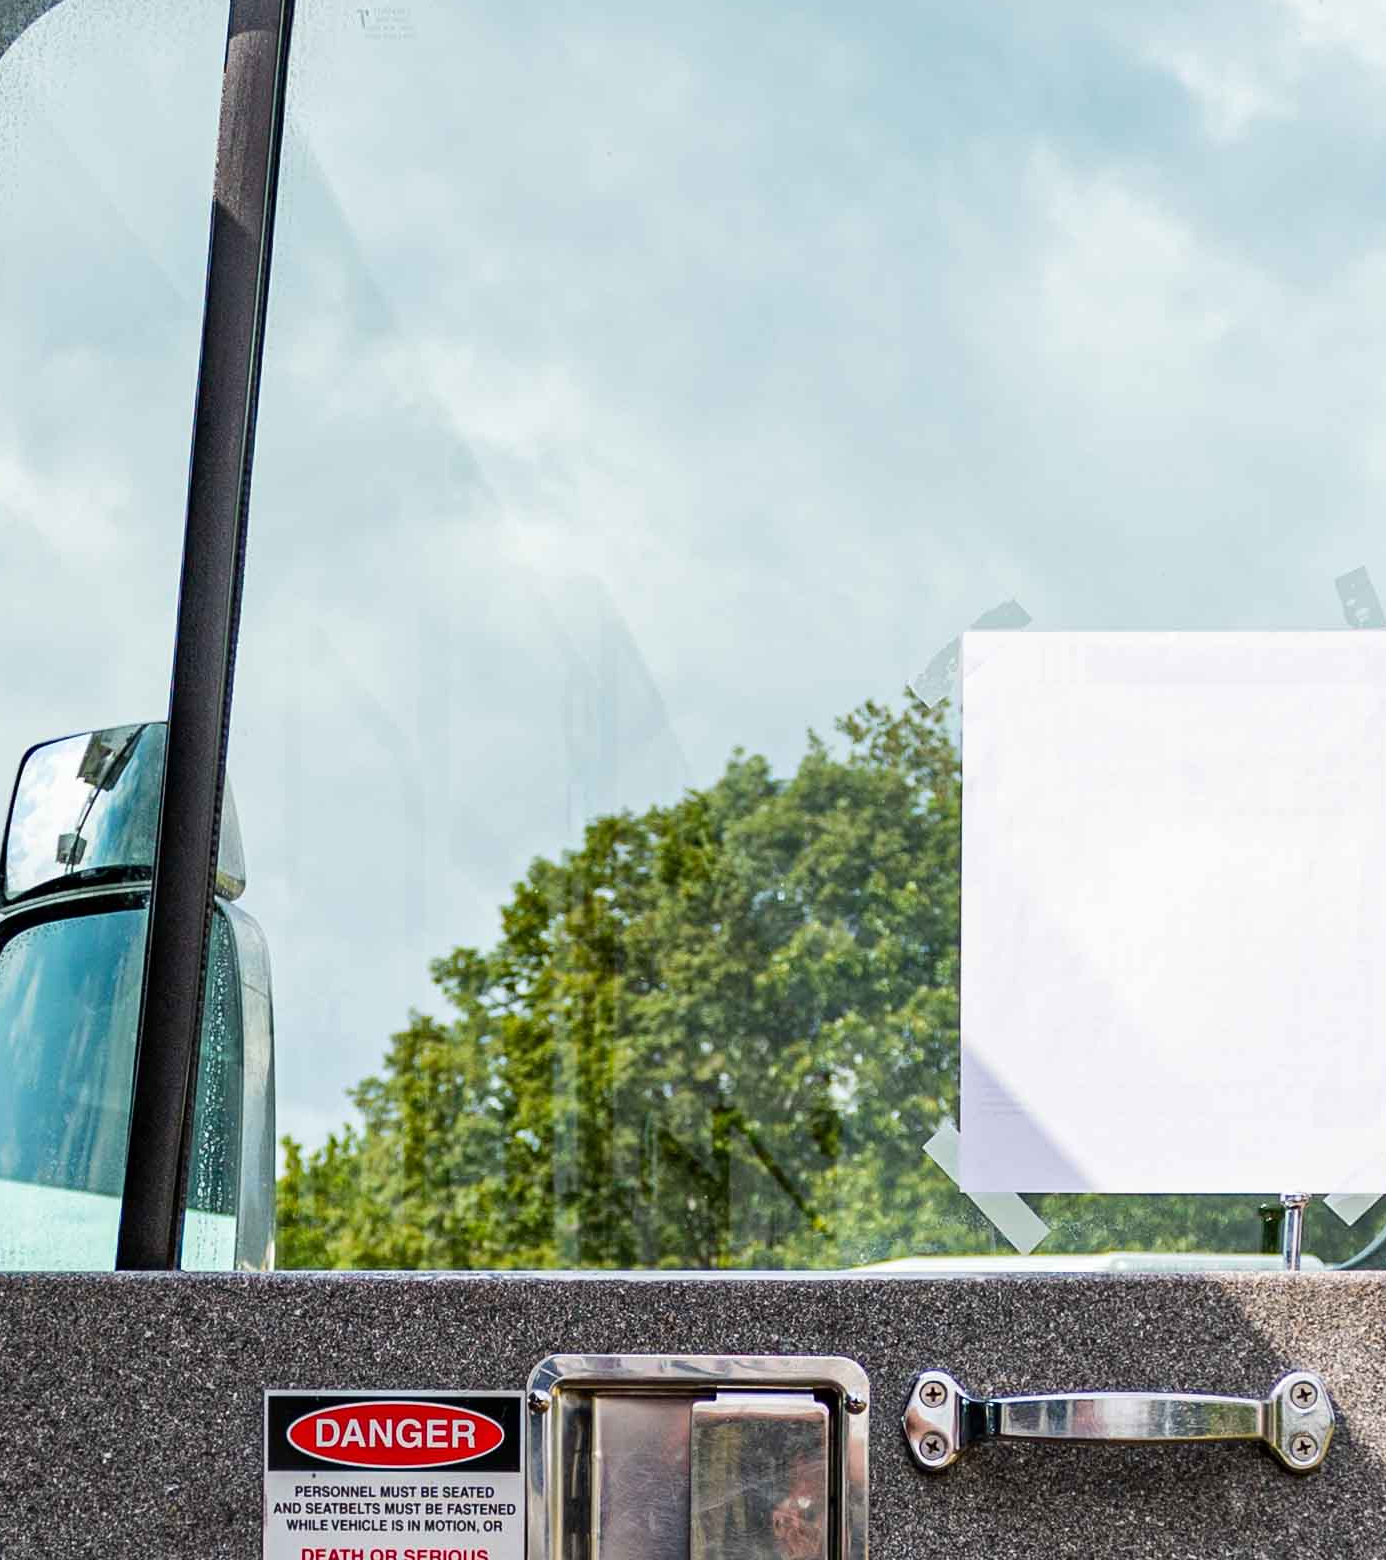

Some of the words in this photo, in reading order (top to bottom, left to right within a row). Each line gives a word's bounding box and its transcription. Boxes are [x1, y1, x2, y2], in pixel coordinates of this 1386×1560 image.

[315, 1418, 476, 1449] DANGER
[295, 1486, 376, 1498] PERSONNEL
[380, 1486, 417, 1498] MUST
[420, 1487, 438, 1498] BE
[442, 1487, 495, 1498] SEATED
[273, 1503, 301, 1514] AND
[306, 1503, 380, 1515] SEATBELTS
[385, 1503, 421, 1515] MUST
[425, 1504, 443, 1515] BE
[447, 1504, 516, 1515] FASTENED
[286, 1519, 328, 1531] WHILE
[332, 1520, 387, 1532] VEHICLE
[391, 1520, 403, 1532] IS
[408, 1520, 420, 1532] IN
[425, 1520, 480, 1533] MOTION,
[483, 1521, 503, 1532] OR
